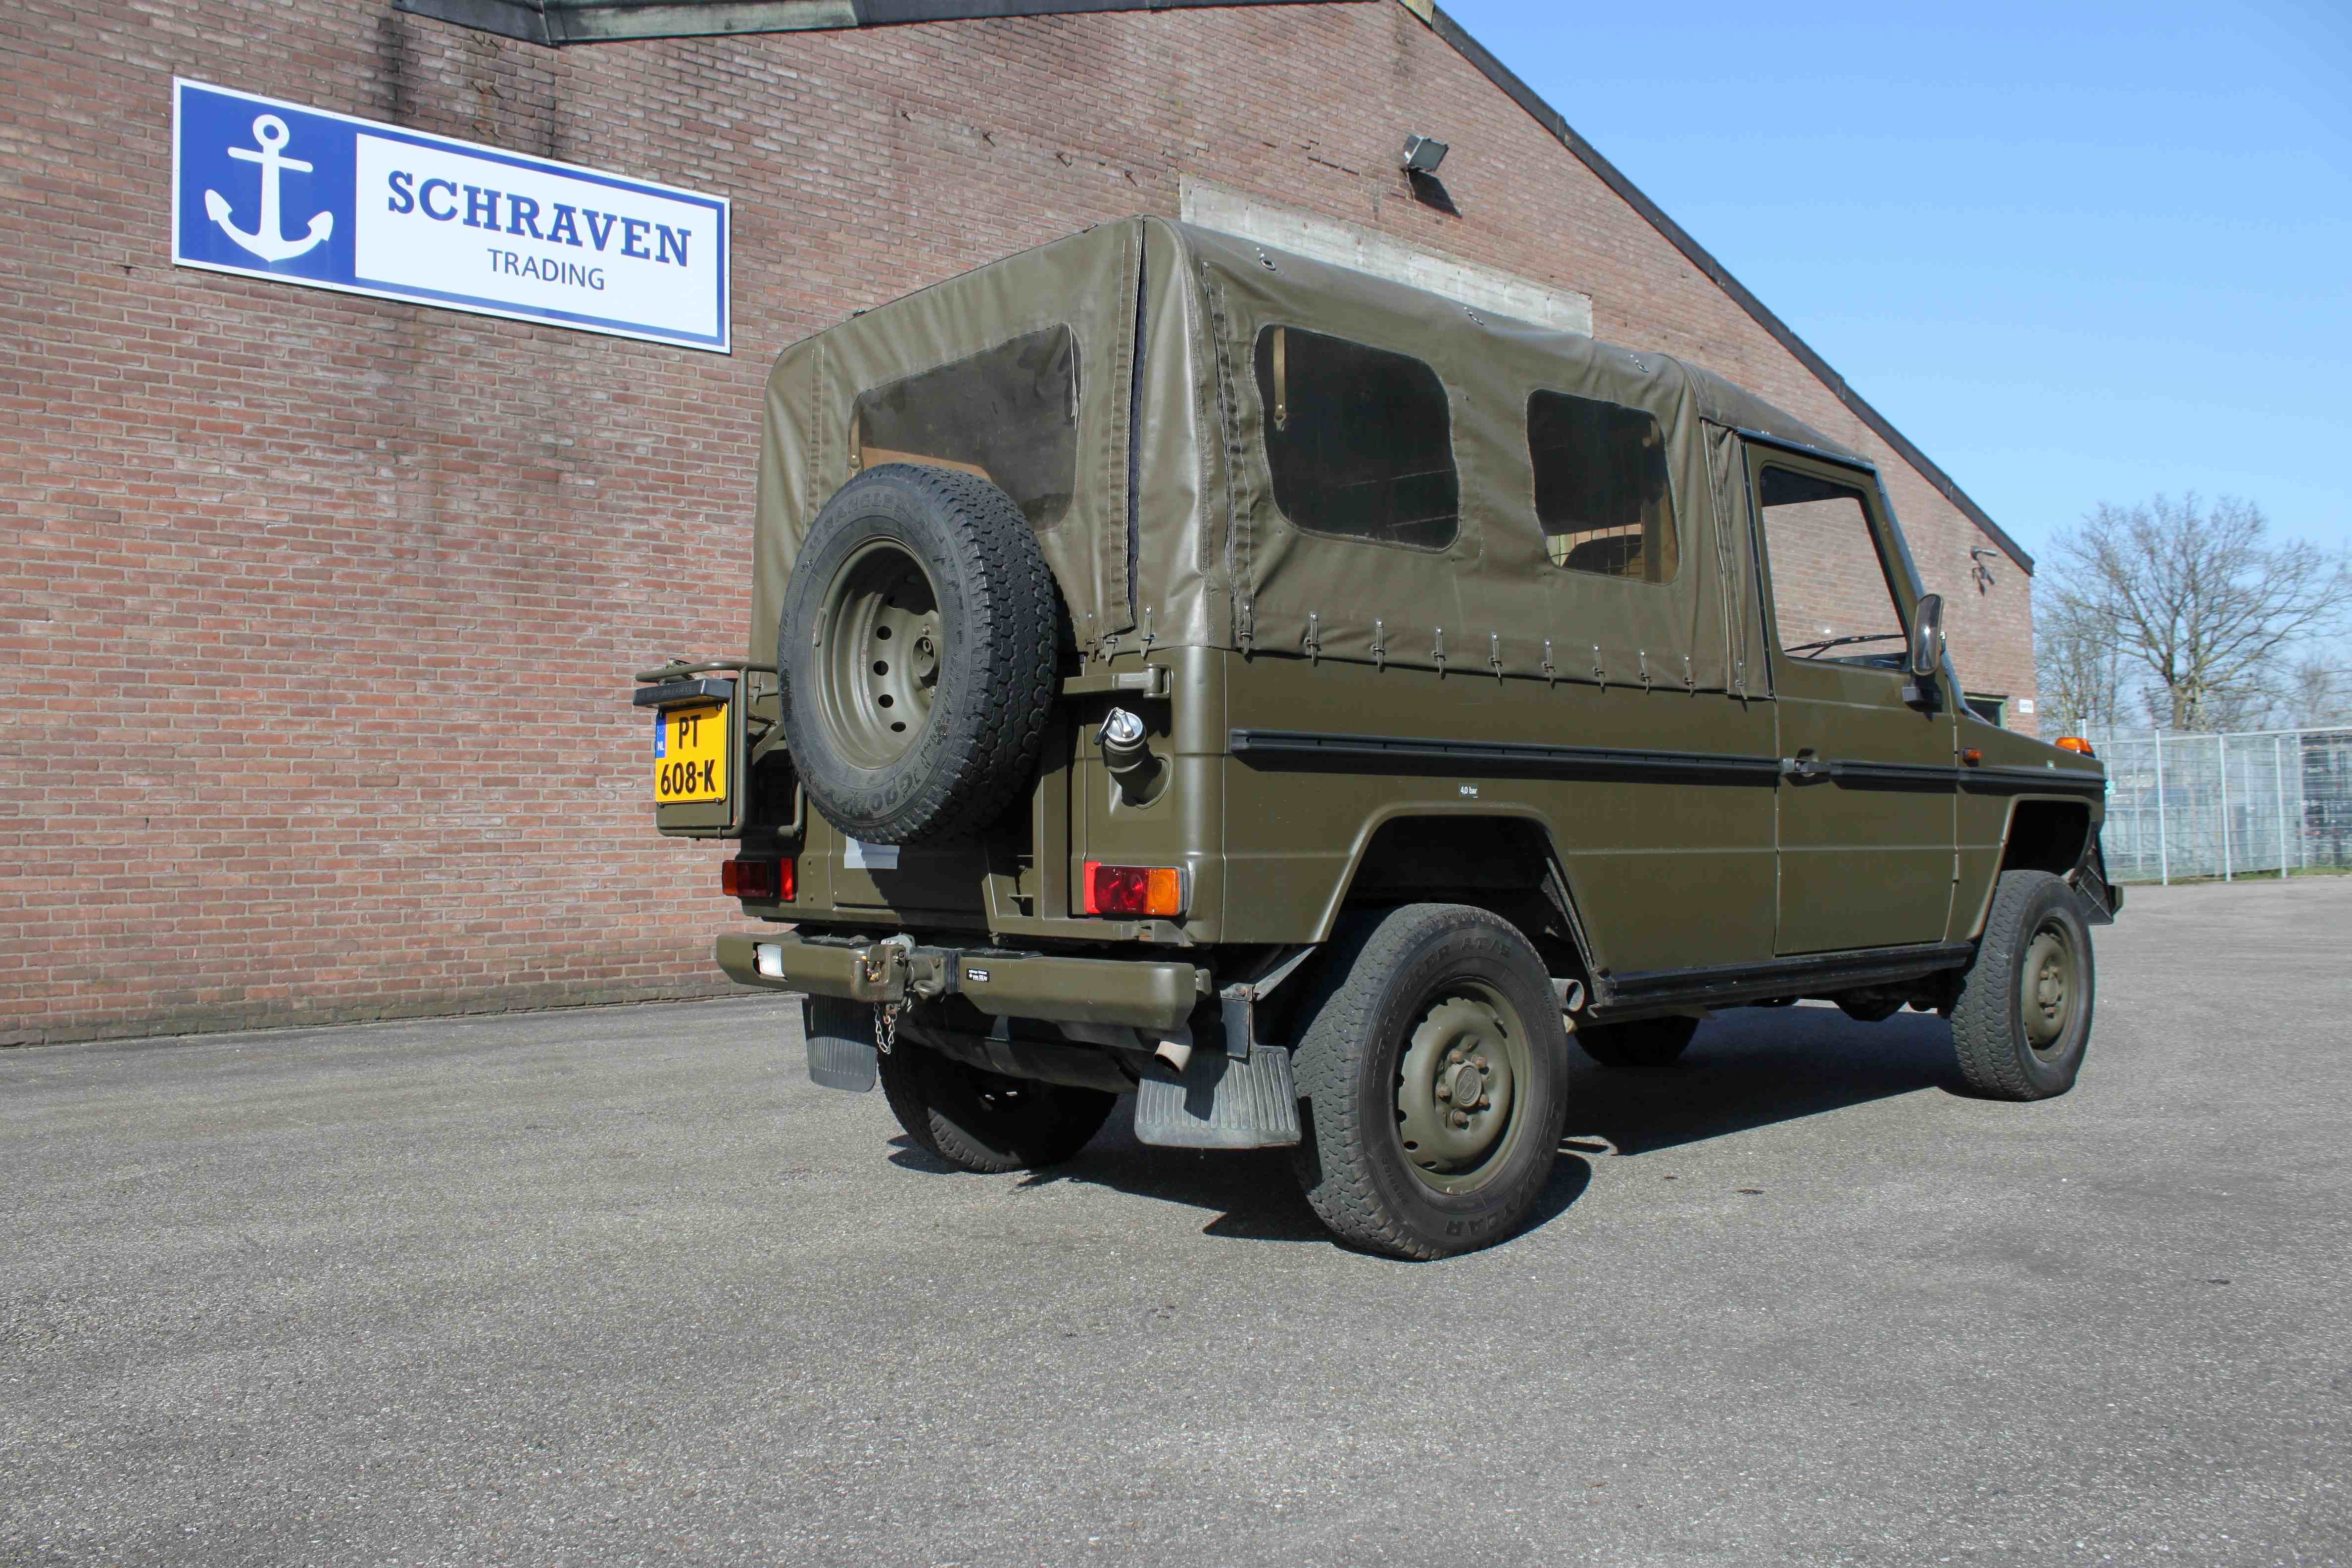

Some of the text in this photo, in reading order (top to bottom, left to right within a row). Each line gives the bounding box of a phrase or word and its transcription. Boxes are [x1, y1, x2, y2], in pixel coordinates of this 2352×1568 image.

[388, 170, 691, 267] SCHRAVEN
[487, 248, 605, 291] TRADING
[657, 741, 665, 751] NL
[678, 714, 701, 750] PT
[660, 759, 716, 796] 608-K
